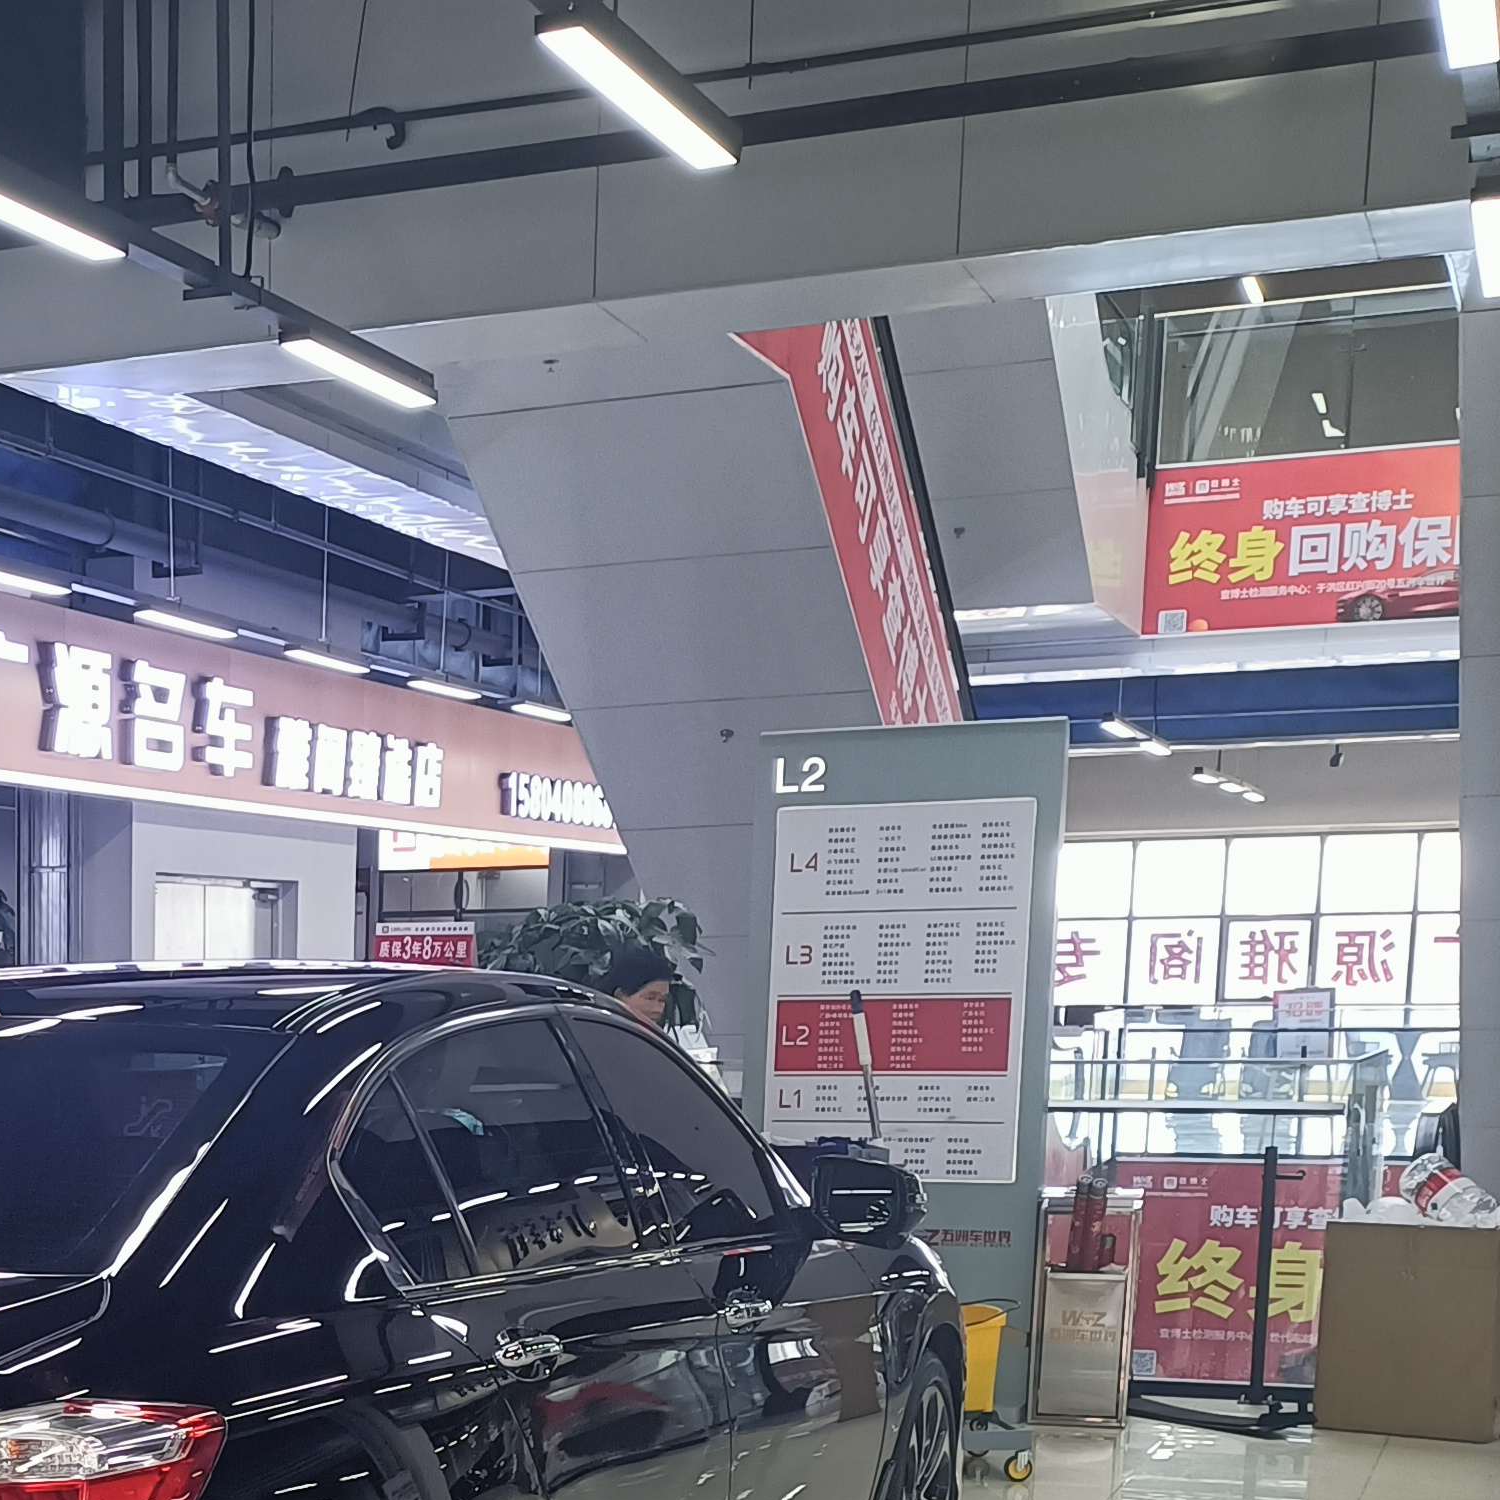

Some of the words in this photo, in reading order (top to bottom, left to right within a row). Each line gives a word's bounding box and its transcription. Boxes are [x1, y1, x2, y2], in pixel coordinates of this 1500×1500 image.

[1263, 489, 1414, 520] 购车可享查博士
[1168, 515, 1460, 585] 终身回购保
[775, 757, 826, 794] L2
[790, 852, 819, 873] L4
[379, 935, 468, 960] 质保3年8万公里
[785, 945, 813, 965] L3
[781, 1025, 810, 1046] L2
[778, 1088, 802, 1109] L1
[1154, 1238, 1323, 1323] 终身
